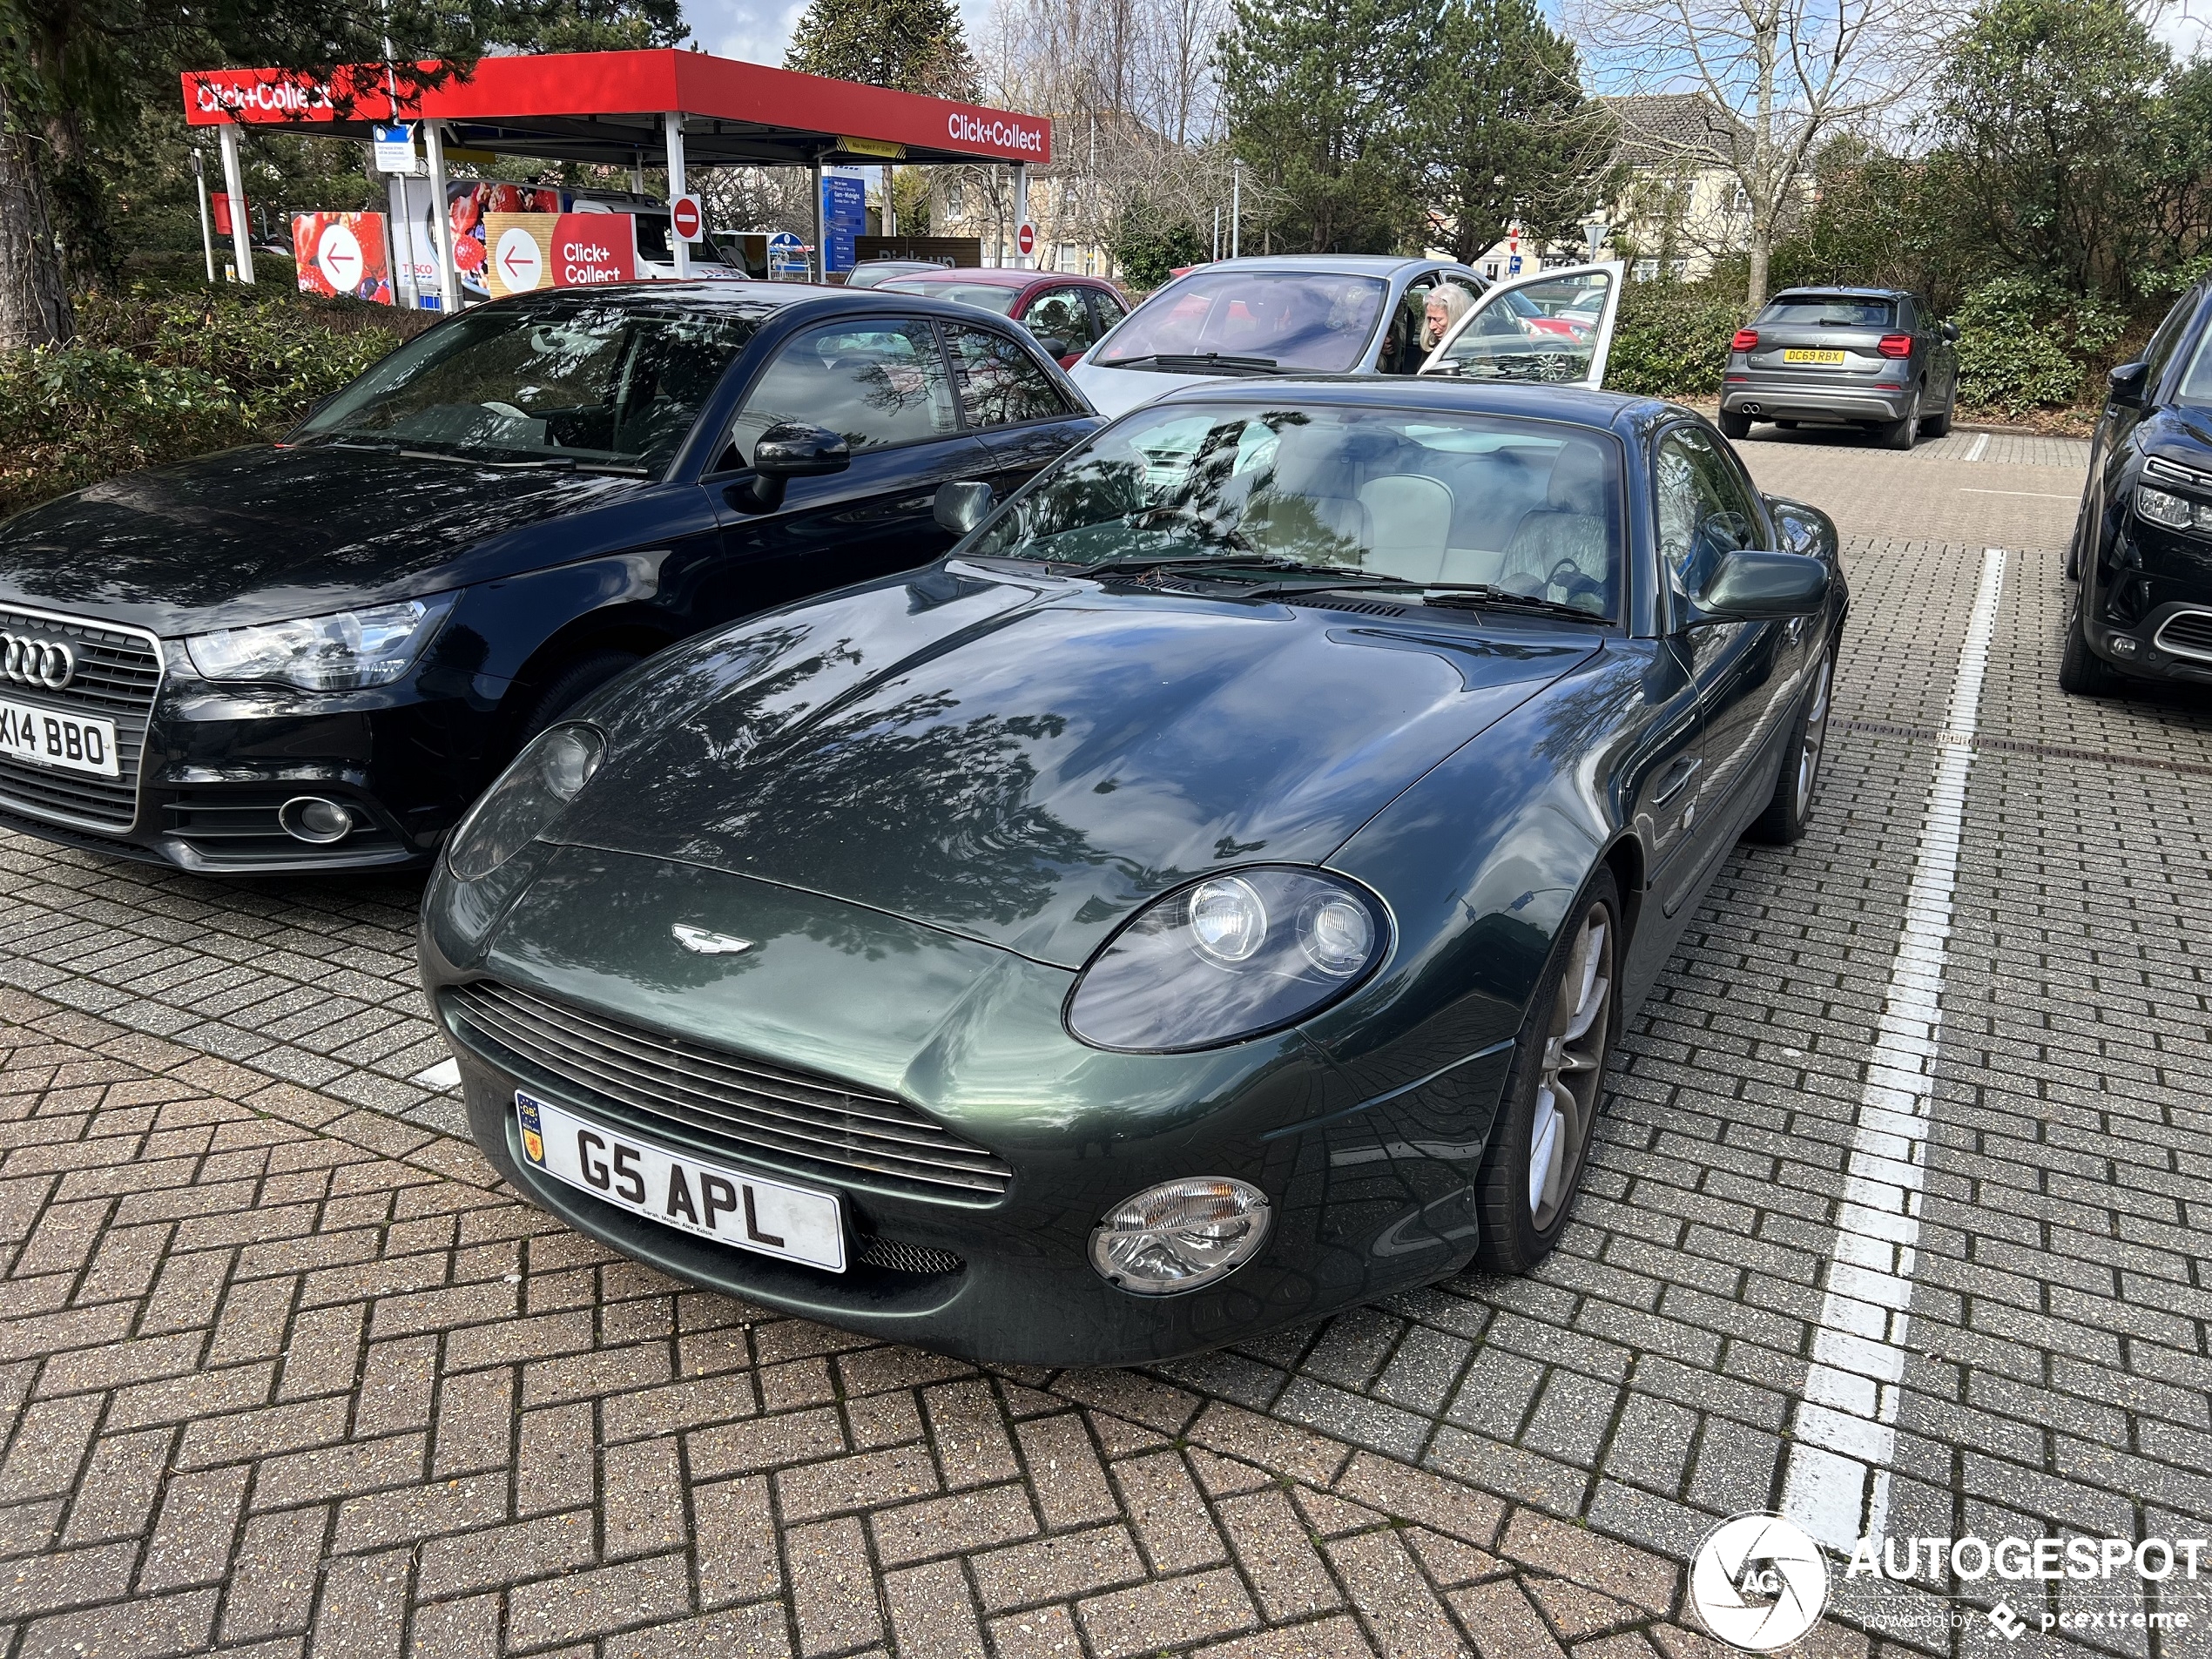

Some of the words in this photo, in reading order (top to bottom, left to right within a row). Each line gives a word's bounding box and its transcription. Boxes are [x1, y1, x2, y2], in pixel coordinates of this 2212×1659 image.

[198, 81, 334, 111] Click+Collect
[948, 113, 1041, 152] Click+Collect
[563, 243, 610, 262] Click+
[402, 264, 432, 274] TSCO
[565, 265, 620, 284] Collect
[1789, 350, 1816, 361] DC69
[1817, 352, 1839, 361] RBX
[44, 716, 104, 765] BBO
[523, 1105, 536, 1117] GB
[577, 1129, 645, 1204] G5
[666, 1163, 784, 1247] APL
